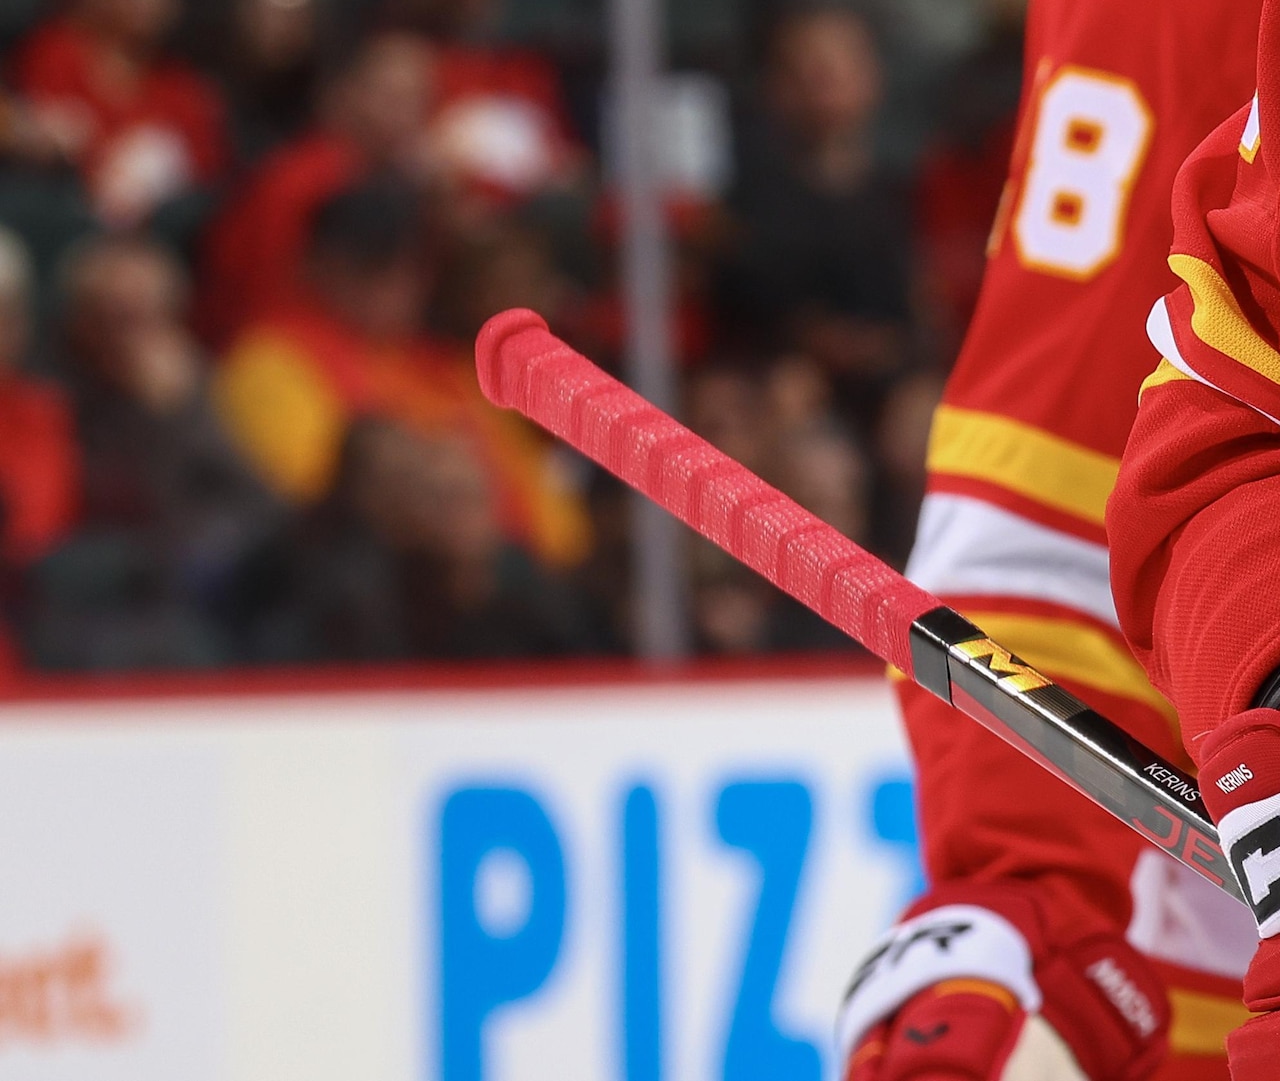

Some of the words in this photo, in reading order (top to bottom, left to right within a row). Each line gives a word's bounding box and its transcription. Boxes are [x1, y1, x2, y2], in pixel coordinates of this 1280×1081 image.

[985, 58, 1156, 283] 8
[1143, 762, 1202, 802] KERINS
[1215, 763, 1255, 795] KERINS
